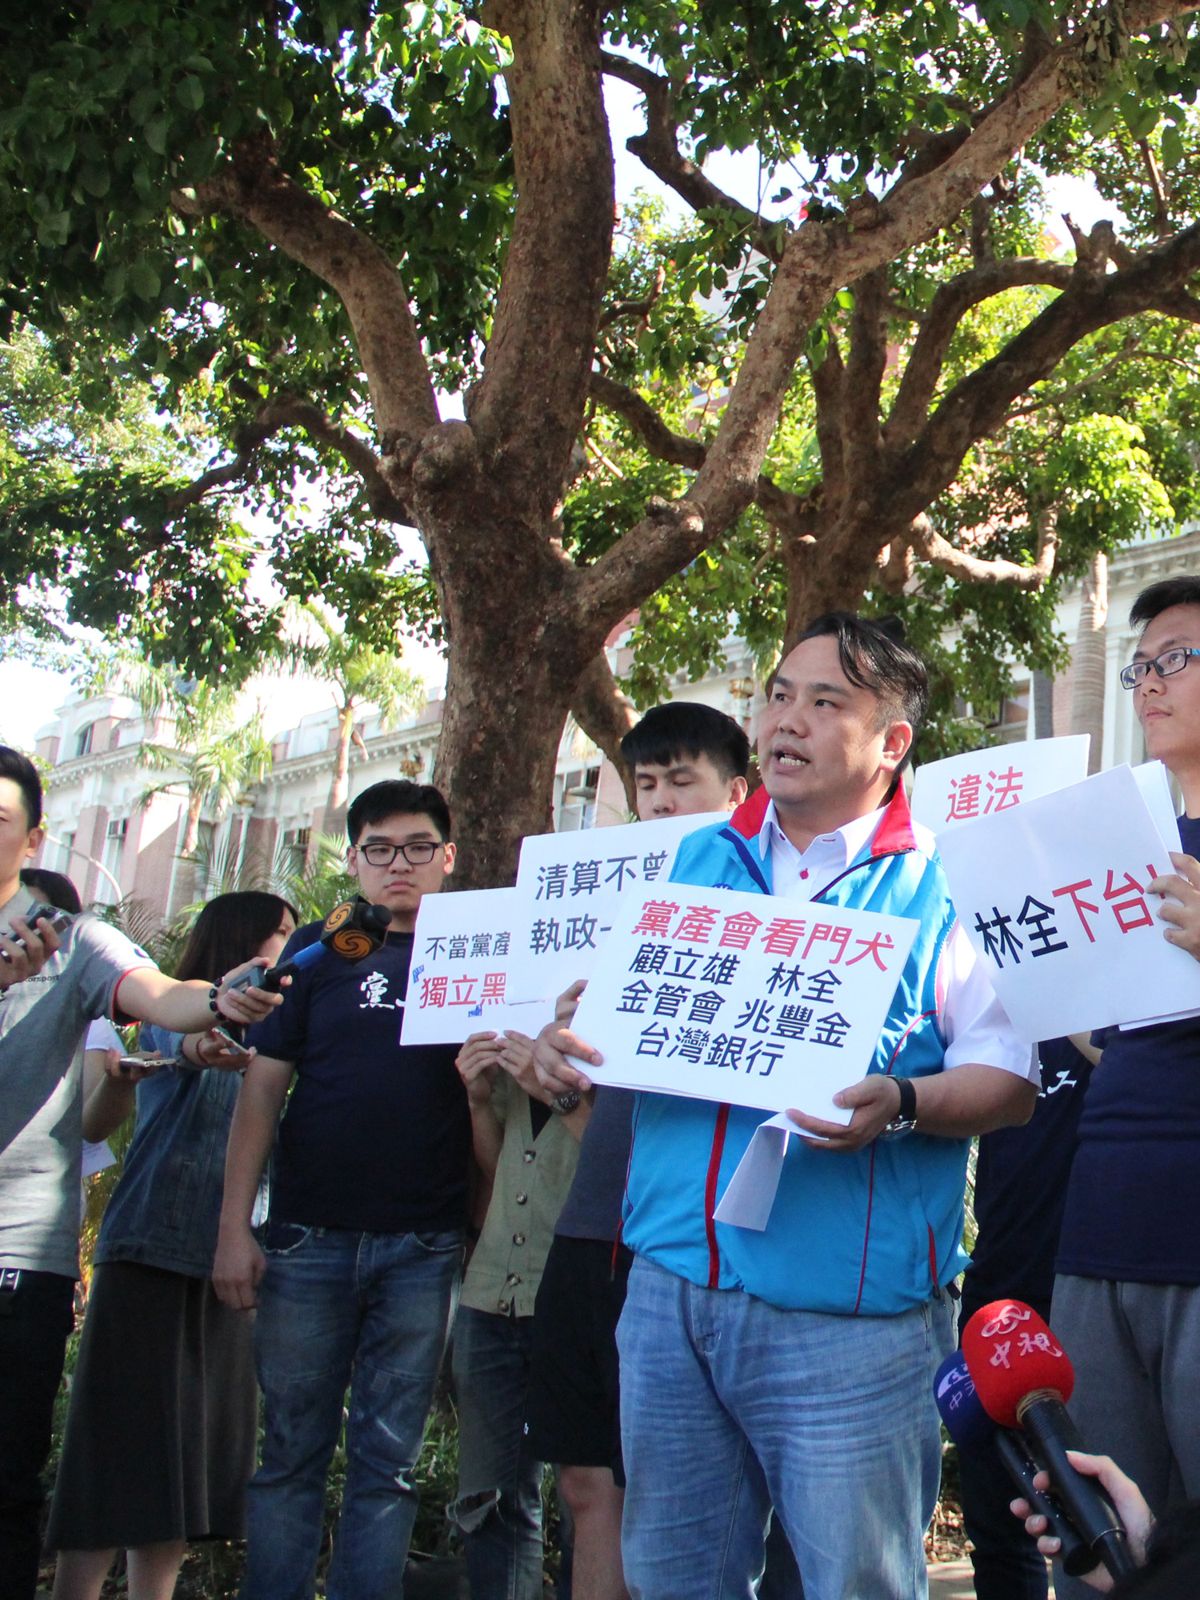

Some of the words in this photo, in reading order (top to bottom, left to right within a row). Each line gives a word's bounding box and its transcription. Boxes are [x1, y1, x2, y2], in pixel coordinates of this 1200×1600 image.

[945, 766, 1024, 822] 違法
[425, 931, 511, 960] 不當黨產
[631, 899, 895, 972] 黨產會看門犬
[628, 942, 741, 986] 顧立雄
[766, 962, 842, 1004] 林全
[616, 979, 726, 1025] 金管會
[734, 998, 852, 1048] 兆豐金
[636, 1021, 786, 1076] 台灣銀行
[990, 1332, 1062, 1369] 中視
